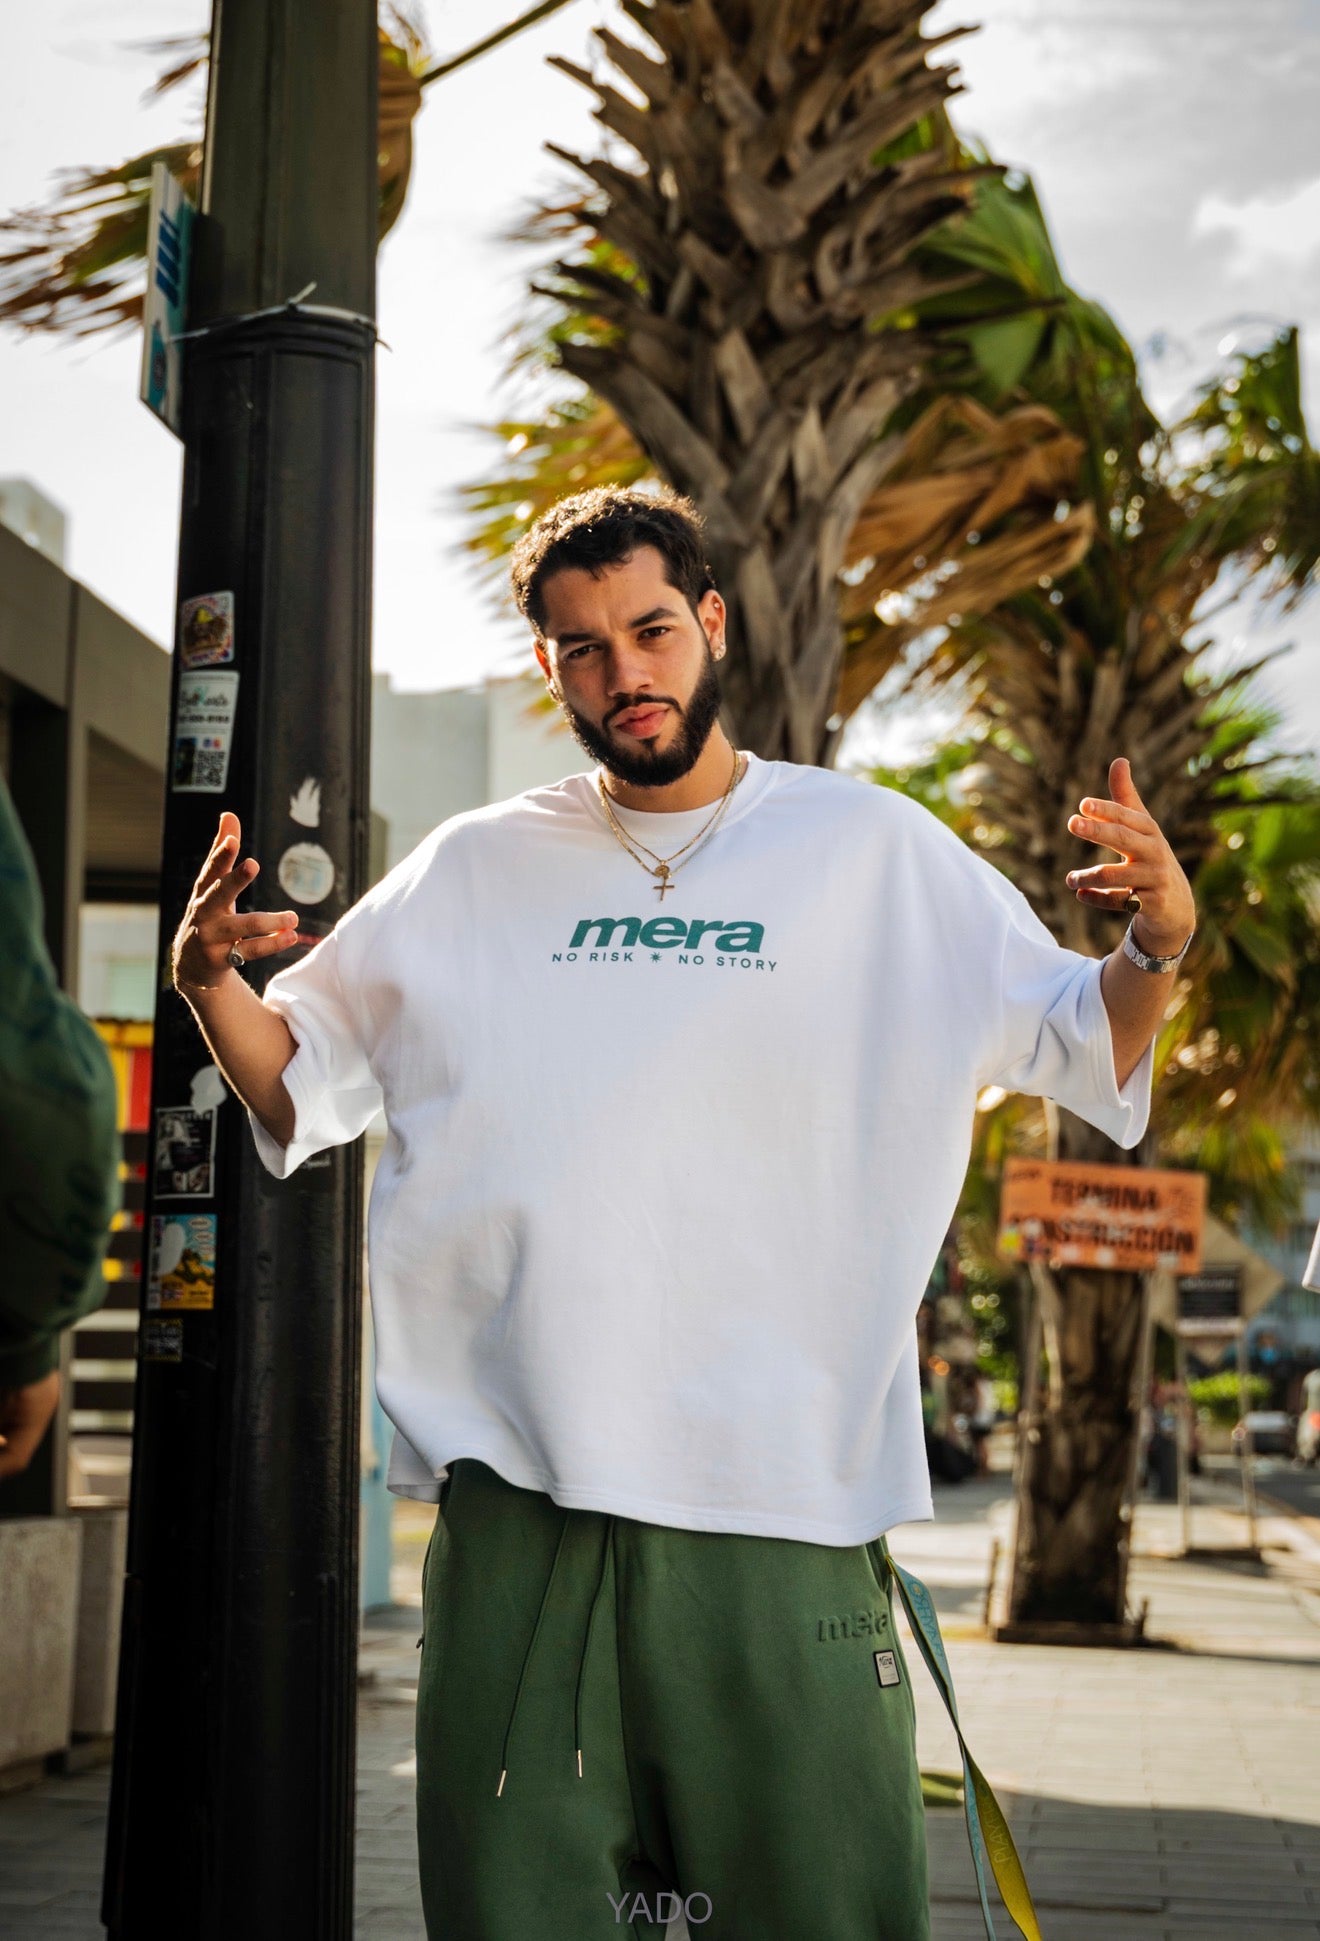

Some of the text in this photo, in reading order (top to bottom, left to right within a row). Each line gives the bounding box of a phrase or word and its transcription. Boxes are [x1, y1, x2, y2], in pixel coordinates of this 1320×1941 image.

[569, 917, 765, 953] mera
[552, 952, 777, 972] NO RISK NO STORY
[1052, 1178, 1158, 1211] TERMINA
[816, 1608, 888, 1643] mera
